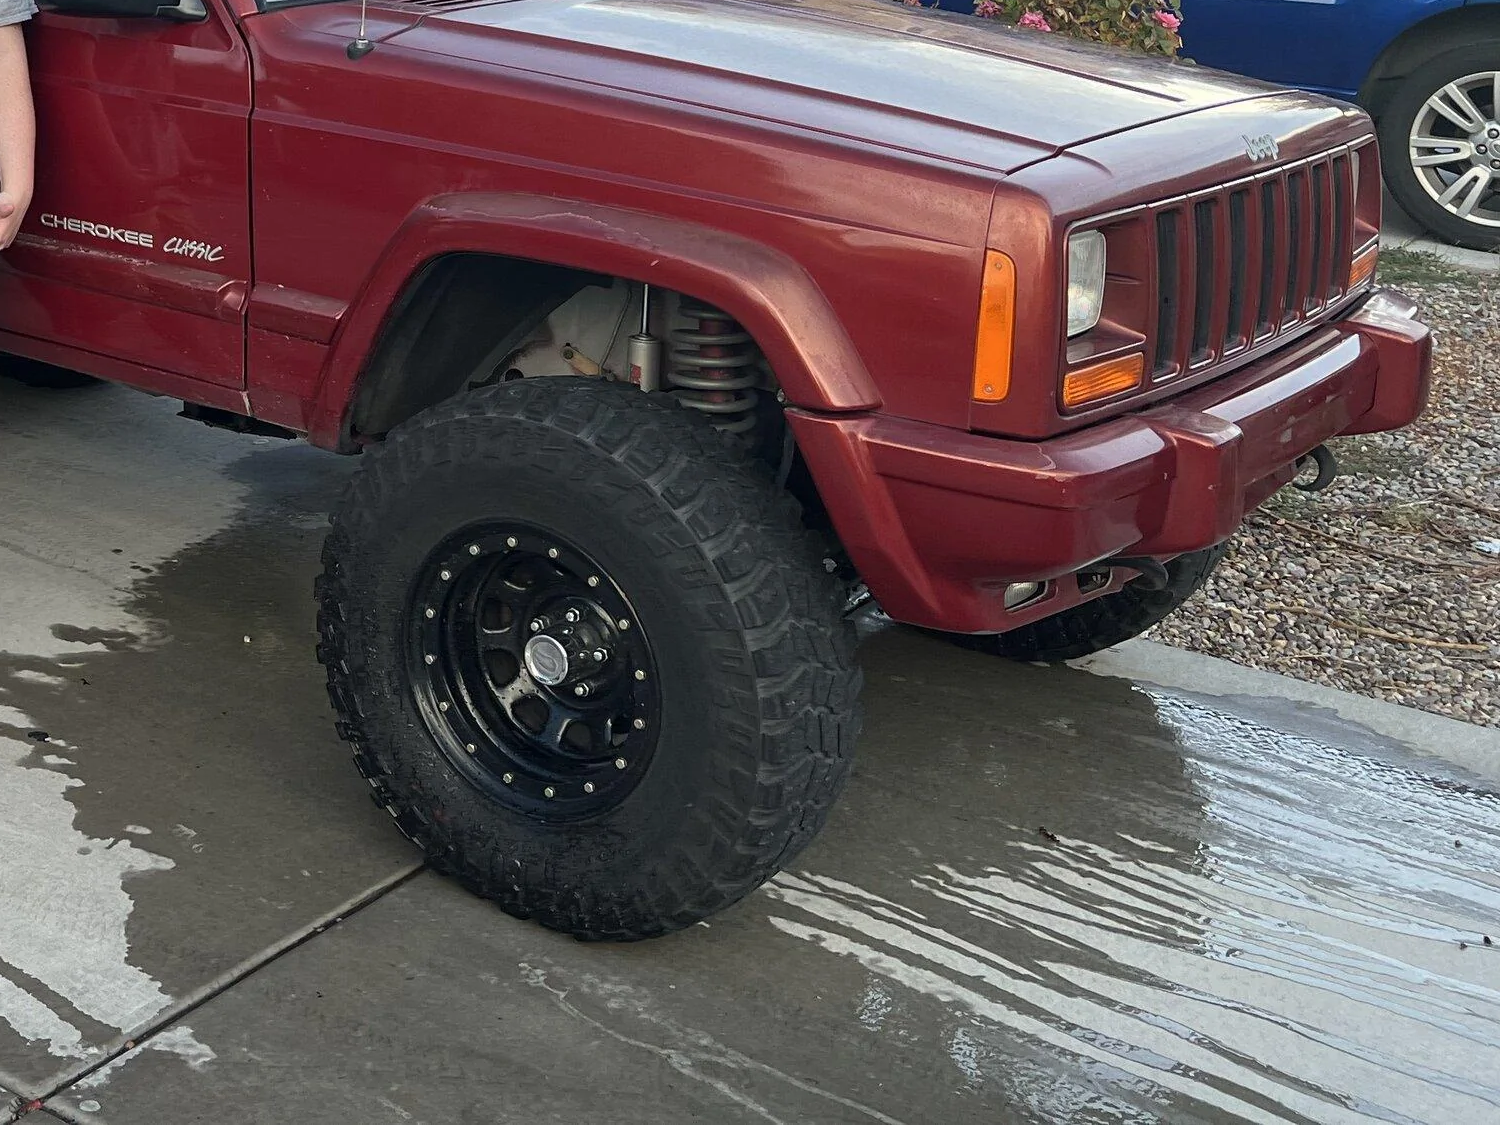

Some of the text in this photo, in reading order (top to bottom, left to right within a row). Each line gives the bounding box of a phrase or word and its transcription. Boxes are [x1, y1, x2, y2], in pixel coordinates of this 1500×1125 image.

[1240, 132, 1279, 162] Jeep
[40, 213, 225, 263] CHEROKEE CLASSIC
